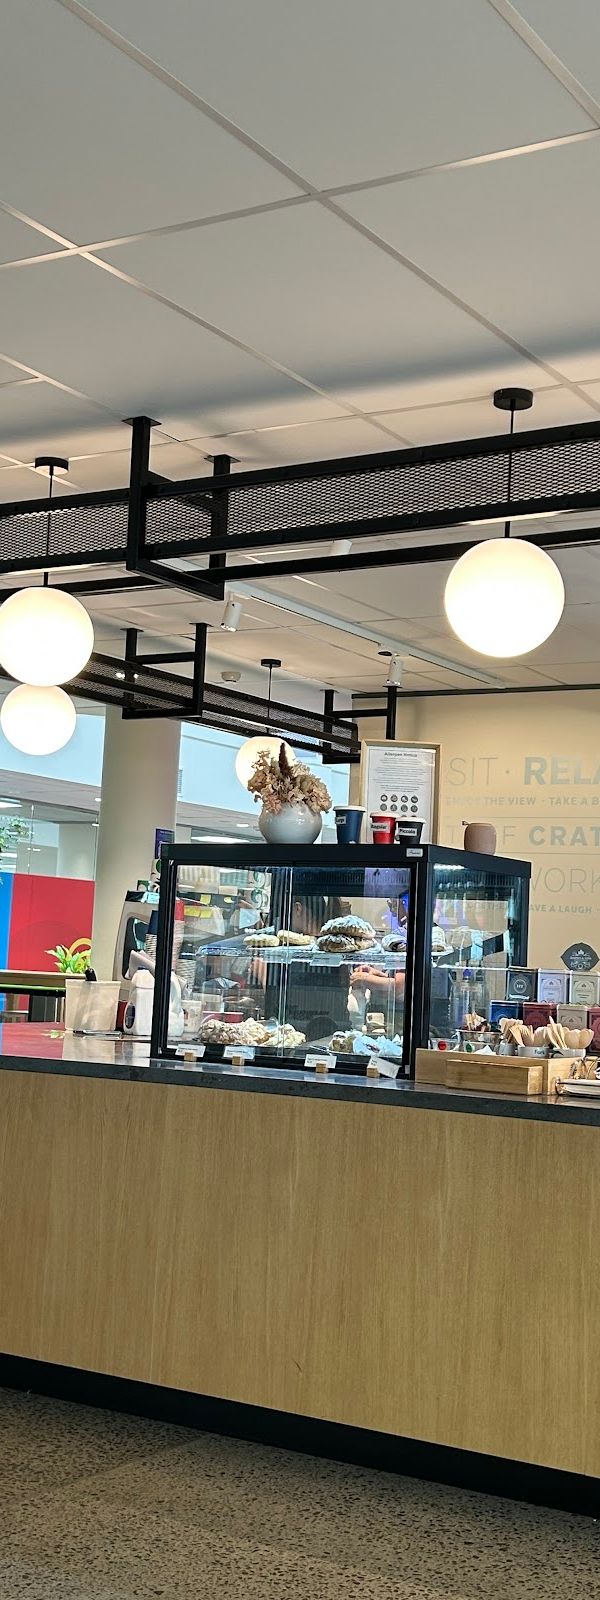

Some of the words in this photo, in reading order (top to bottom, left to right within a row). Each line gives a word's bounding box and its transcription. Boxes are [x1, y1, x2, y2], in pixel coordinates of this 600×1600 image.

[449, 757, 499, 786] SIT
[483, 796, 505, 806] THE
[508, 796, 536, 806] VIEW
[549, 796, 577, 806] TAKE
[580, 796, 588, 806] A
[558, 904, 592, 914] LAUGH
